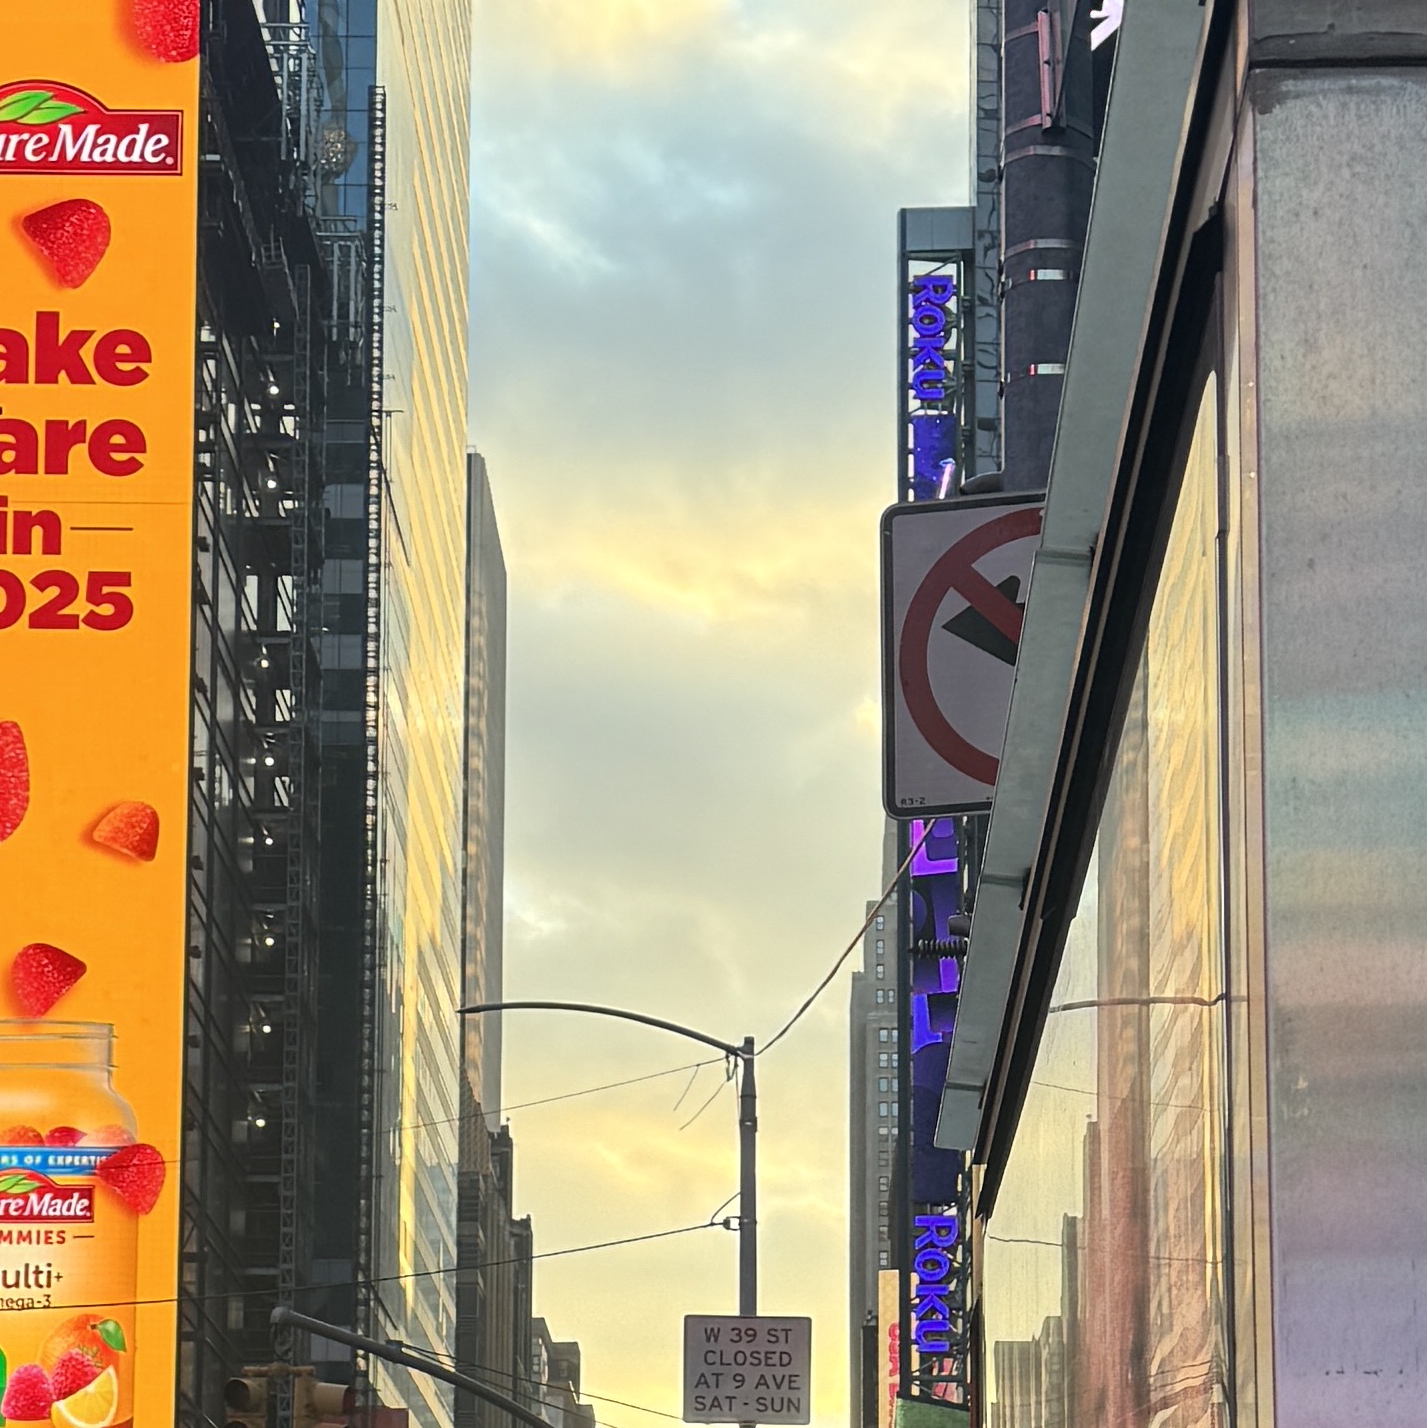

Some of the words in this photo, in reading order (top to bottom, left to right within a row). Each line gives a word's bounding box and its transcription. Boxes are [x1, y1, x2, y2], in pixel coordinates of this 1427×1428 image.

[24, 1155, 41, 1165] OF
[48, 1155, 110, 1166] EXPERTI
[704, 1327, 721, 1343] W
[730, 1327, 757, 1343] 39
[767, 1328, 792, 1344] ST
[704, 1350, 792, 1367] CLOSED
[694, 1373, 724, 1389] AT
[733, 1373, 746, 1389] 9
[754, 1374, 801, 1390] AVE
[694, 1395, 737, 1412] SAT
[755, 1397, 801, 1413] SUN
